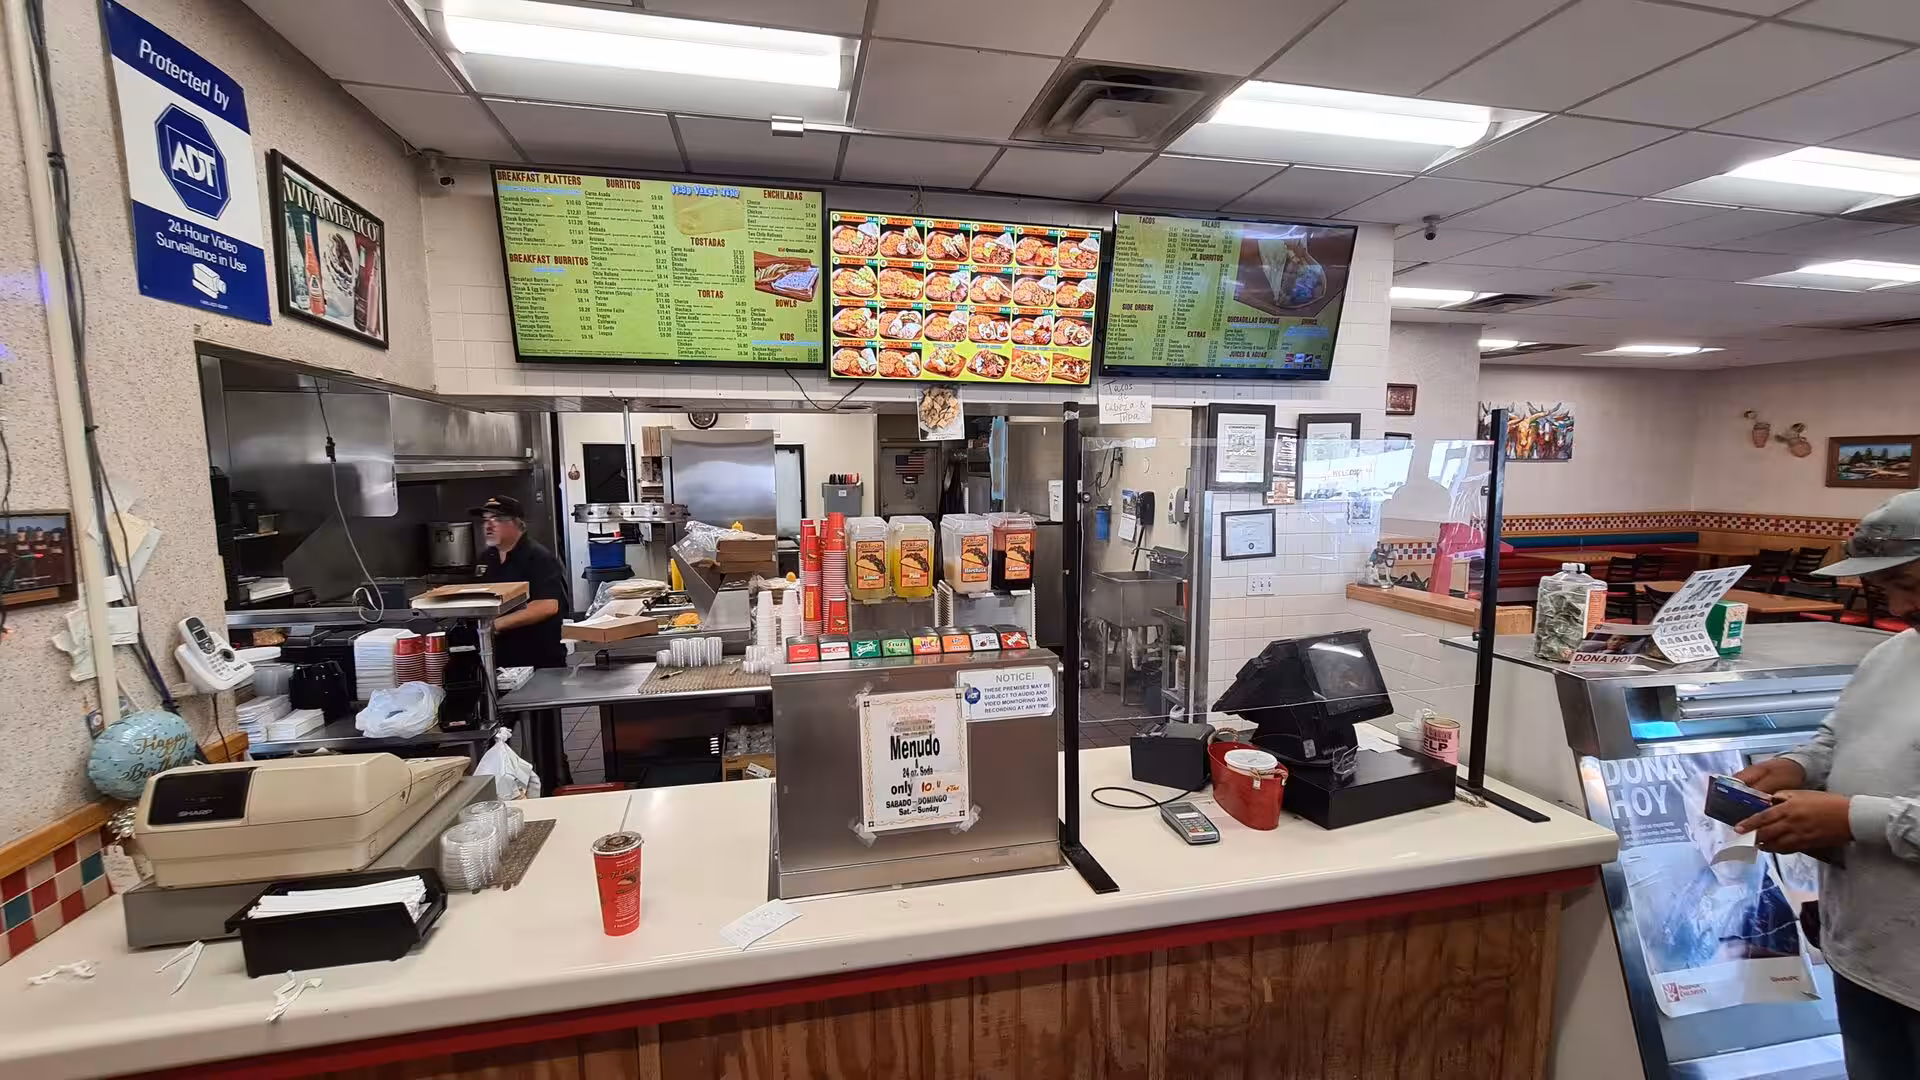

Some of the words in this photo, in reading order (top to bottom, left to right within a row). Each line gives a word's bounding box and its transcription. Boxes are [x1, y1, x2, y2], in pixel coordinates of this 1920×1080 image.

[139, 38, 211, 97] Protected
[214, 84, 230, 111] by
[172, 141, 216, 187] ADT
[497, 171, 540, 183] BREAKFAST
[544, 174, 581, 185] PLATTERS
[606, 179, 640, 189] BURRITOS
[284, 175, 325, 219] VIVA
[764, 190, 803, 200] ENCHILADAS
[1139, 216, 1155, 224] TACOS
[168, 219, 209, 245] 24-Hour
[211, 233, 238, 254] Video
[690, 237, 726, 247] TOSTADAS
[156, 232, 217, 263] Surveillance
[218, 253, 228, 267] in
[229, 256, 247, 273] Use
[509, 253, 550, 264] BREAKFAST
[554, 256, 588, 265] BURRITOS
[1200, 254, 1224, 262] BURRITOS
[698, 290, 724, 298] TORTAS
[776, 299, 797, 307] BOWLS
[780, 333, 795, 341] KIDS
[1187, 330, 1206, 338] EXTRAS
[1102, 380, 1133, 394] Tacos
[1574, 654, 1608, 663] DONA
[1610, 654, 1637, 663] HOY
[128, 732, 189, 759] Happy
[890, 734, 940, 760] Menudo
[902, 768, 909, 778] 24
[920, 765, 933, 776] Soda
[1601, 755, 1688, 786] DONA
[891, 780, 913, 797] only
[886, 798, 911, 808] SABADO
[918, 794, 948, 805] DOMINGO
[1612, 784, 1668, 819] HOY
[177, 809, 214, 817] SHARP
[918, 805, 939, 814] Sunday
